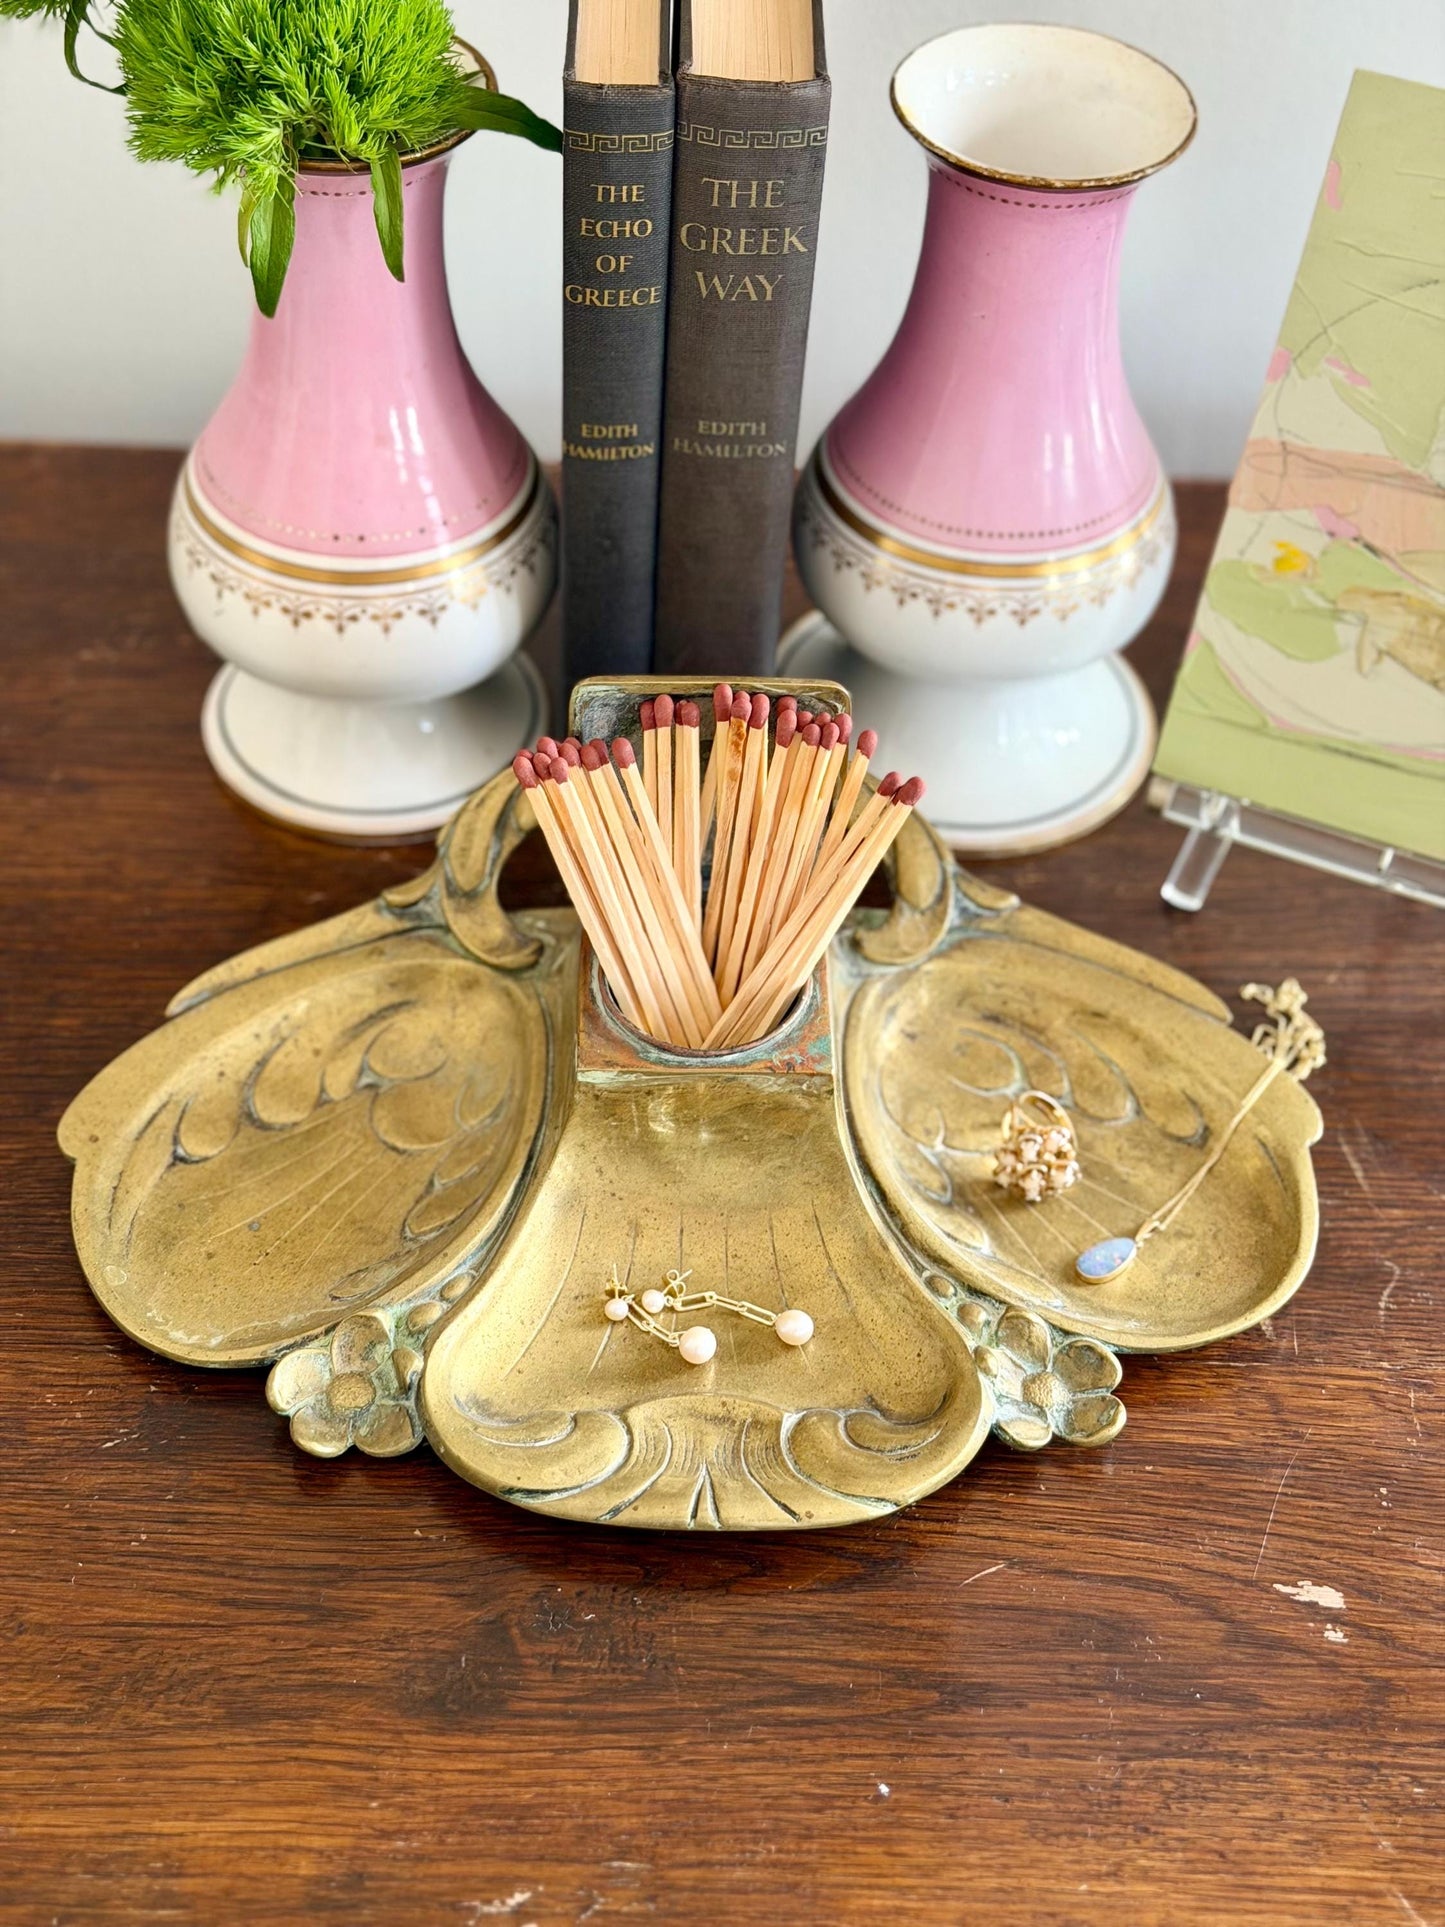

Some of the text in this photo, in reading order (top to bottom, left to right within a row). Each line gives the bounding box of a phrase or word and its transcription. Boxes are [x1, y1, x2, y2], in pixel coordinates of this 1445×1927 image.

[590, 184, 645, 203] THE
[701, 177, 785, 208] THE
[580, 217, 653, 238] ECHO
[680, 222, 808, 255] GREEK
[596, 254, 634, 273] OF
[565, 284, 662, 307] GREECE
[695, 270, 784, 301] WAY
[581, 423, 638, 439] EDITH
[698, 420, 766, 436] EDITH
[562, 440, 655, 461] HAMILTON
[673, 437, 788, 458] HAMILTON
